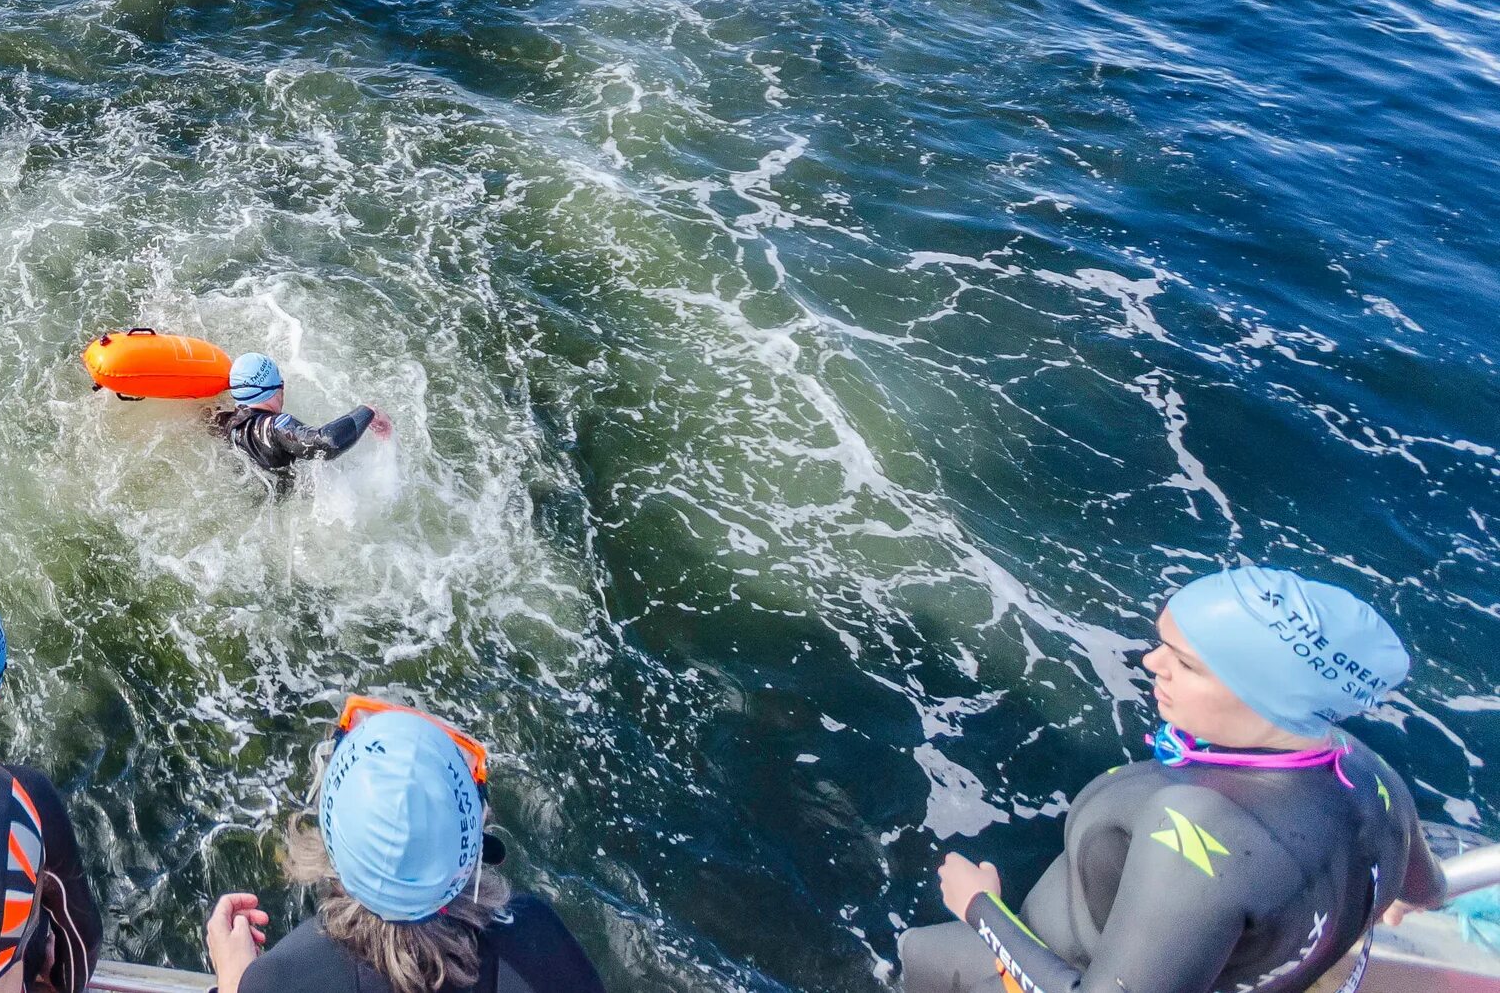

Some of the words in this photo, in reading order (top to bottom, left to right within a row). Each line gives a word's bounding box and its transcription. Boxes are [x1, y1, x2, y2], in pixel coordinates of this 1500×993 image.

[1269, 620, 1338, 680] FJORD
[1288, 611, 1330, 651] THE
[334, 755, 360, 791] THE
[448, 761, 477, 831] SWIM
[453, 788, 471, 868] GREAT
